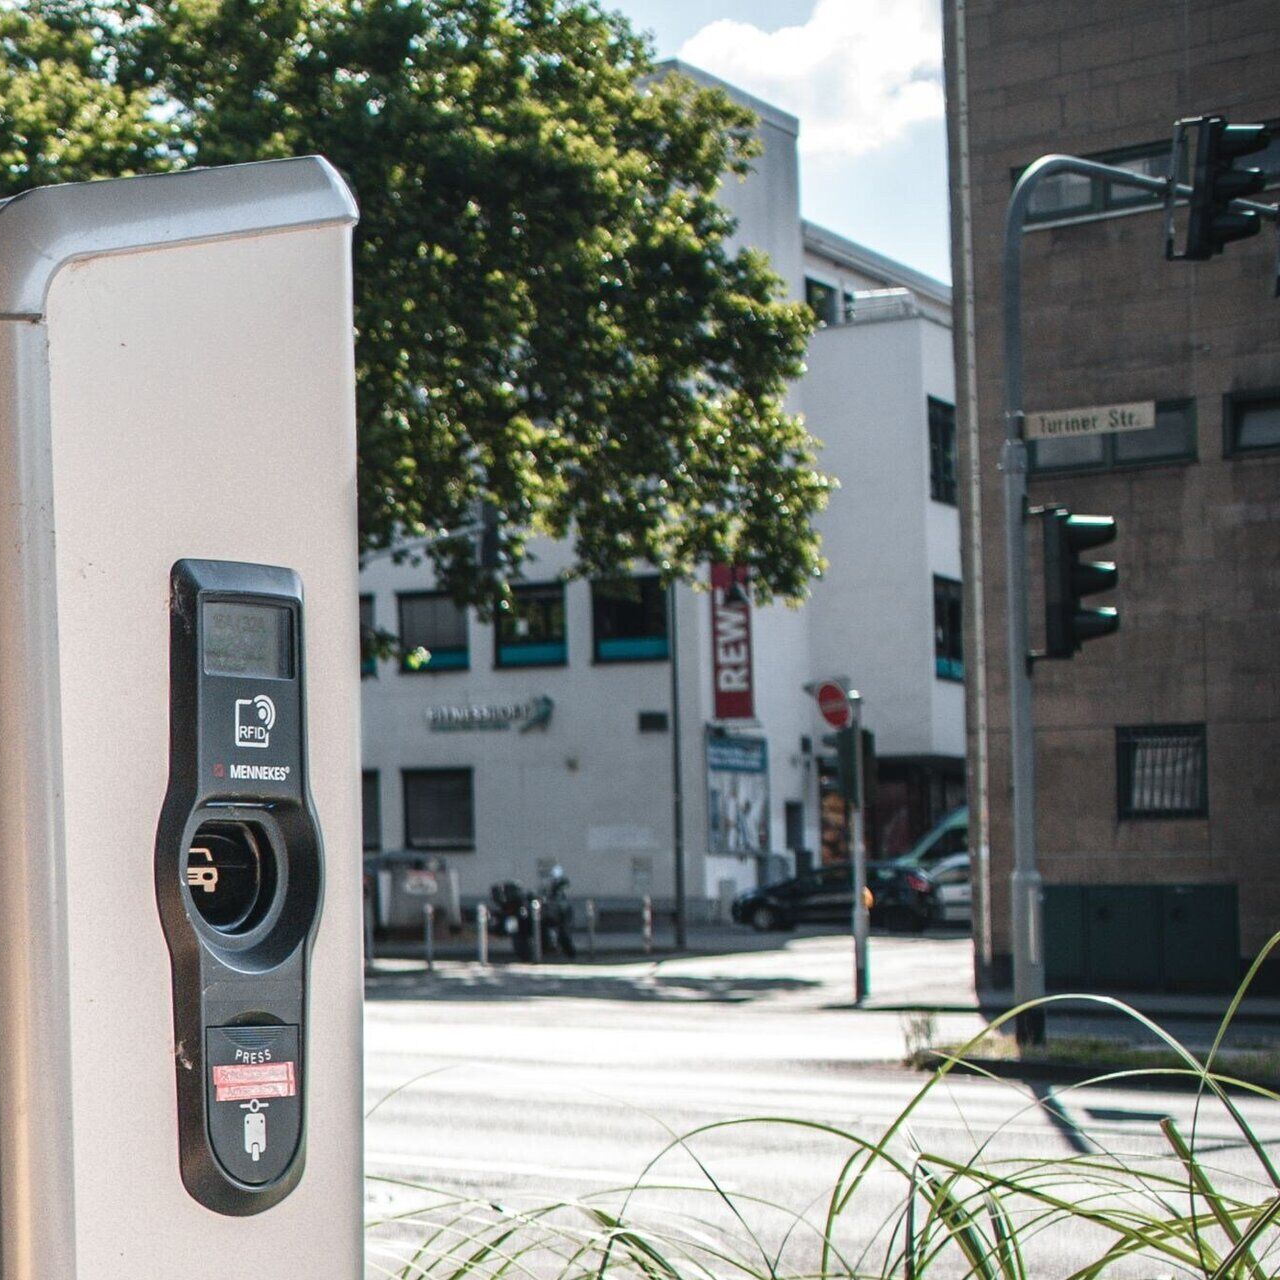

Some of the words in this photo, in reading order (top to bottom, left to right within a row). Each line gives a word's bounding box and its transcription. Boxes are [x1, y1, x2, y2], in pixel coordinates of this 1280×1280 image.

[1038, 414, 1099, 434] Turiner
[239, 725, 266, 740] RFID
[235, 1049, 272, 1064] PRESS
